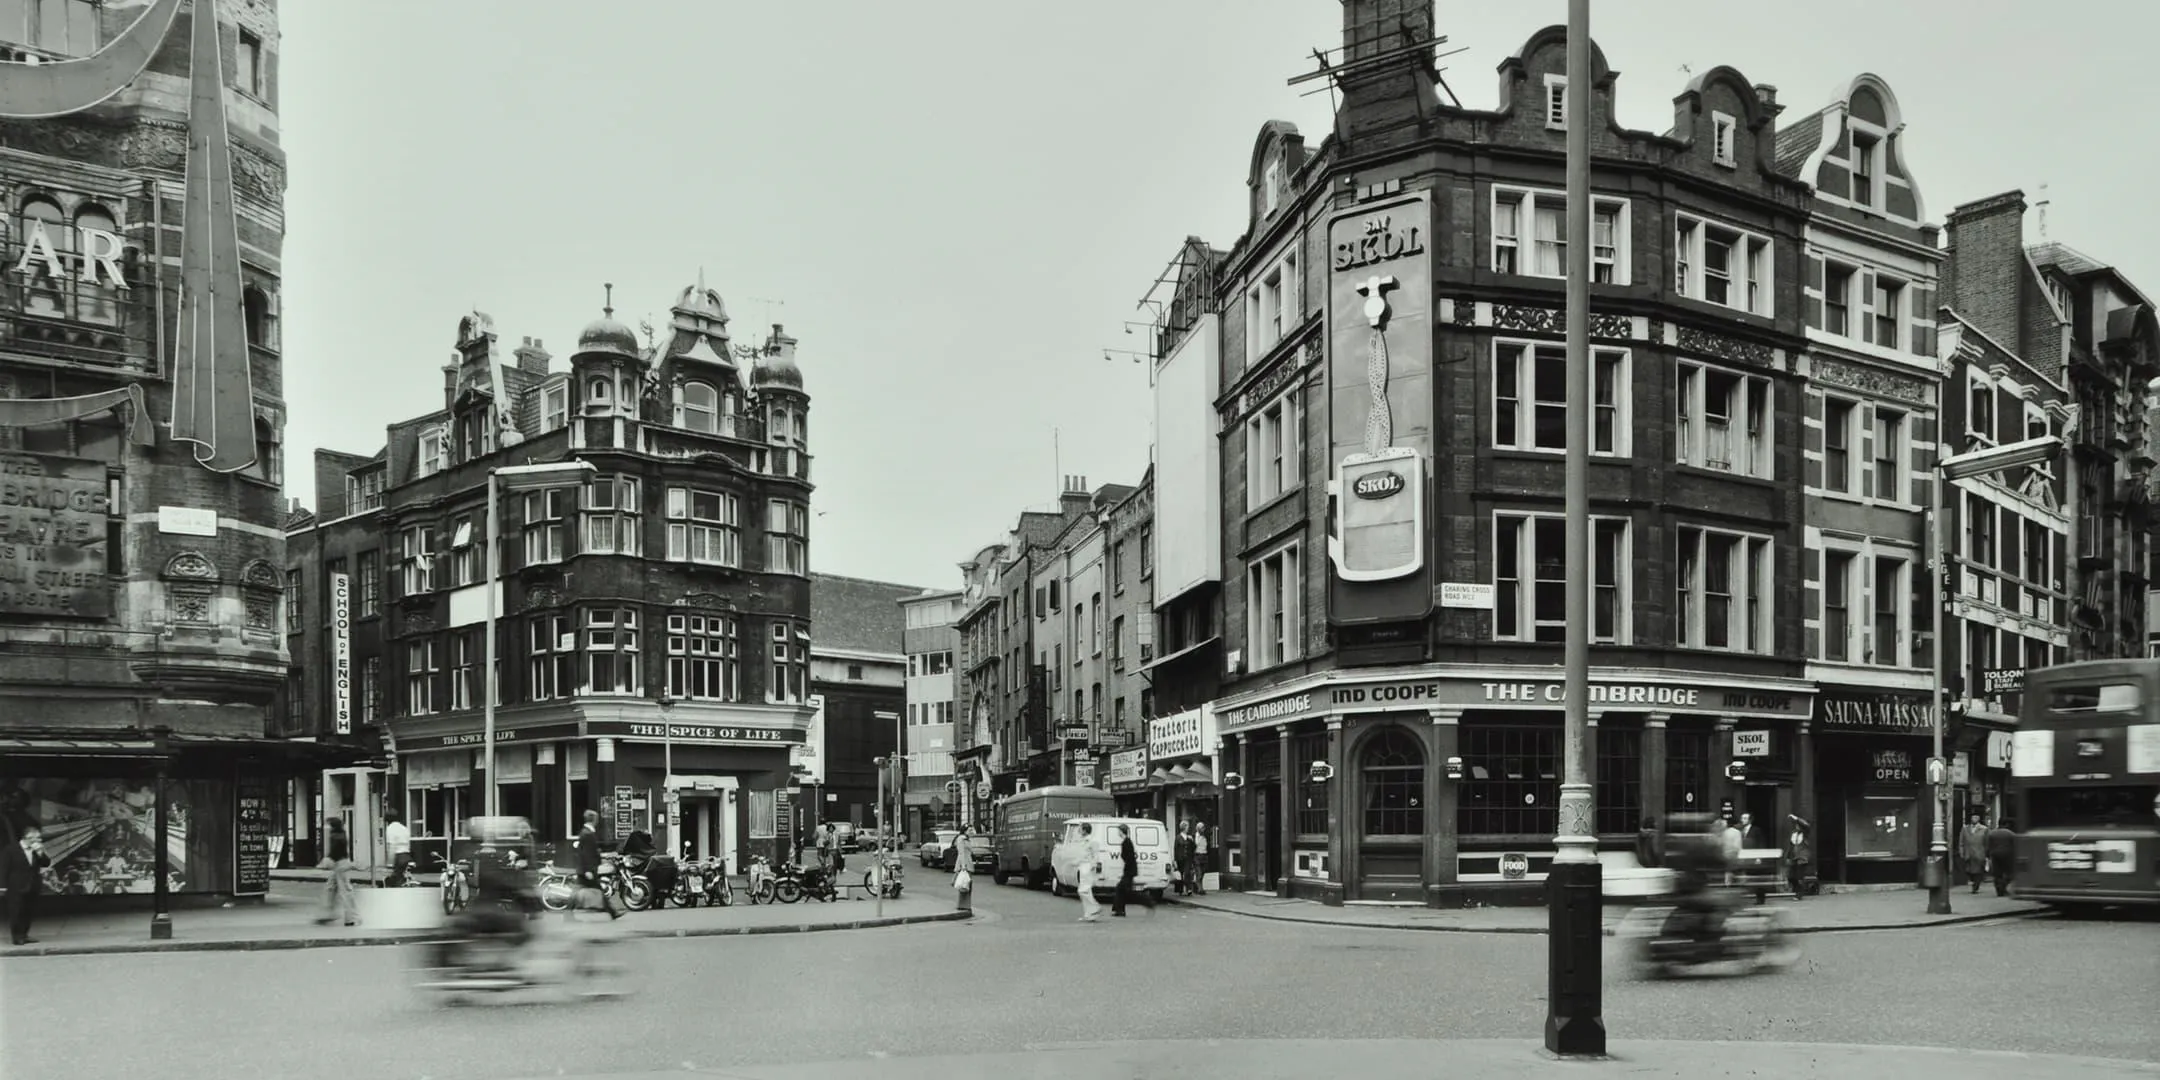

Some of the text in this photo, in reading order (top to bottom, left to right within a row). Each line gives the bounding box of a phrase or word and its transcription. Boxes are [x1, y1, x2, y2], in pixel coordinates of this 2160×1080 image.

[1335, 228, 1424, 271] SKOL
[1358, 476, 1400, 493] SKOL
[1444, 585, 1490, 594] CHARING CROSS
[337, 578, 347, 639] SCHOOL
[1984, 669, 2025, 679] TOLSON
[338, 659, 348, 730] ENGLISH
[1332, 684, 1439, 704] IND COOPE
[1481, 683, 1699, 706] THE CMBRIDGE
[1723, 694, 1792, 710] IND COOPE
[1227, 694, 1312, 726] THE CAMBRIDGE
[442, 736, 459, 745] THE
[460, 733, 483, 744] SPICE
[496, 730, 516, 741] LIFE
[630, 724, 781, 740] THE SPICE OF LIFE
[1152, 718, 1197, 741] Trattoria
[1151, 735, 1199, 757] Cappuccetto
[1737, 734, 1765, 744] SKOL
[1741, 745, 1761, 754] Lager
[1876, 768, 1910, 780] OPEN
[1110, 852, 1158, 861] WDS
[1504, 861, 1525, 870] FOOD
